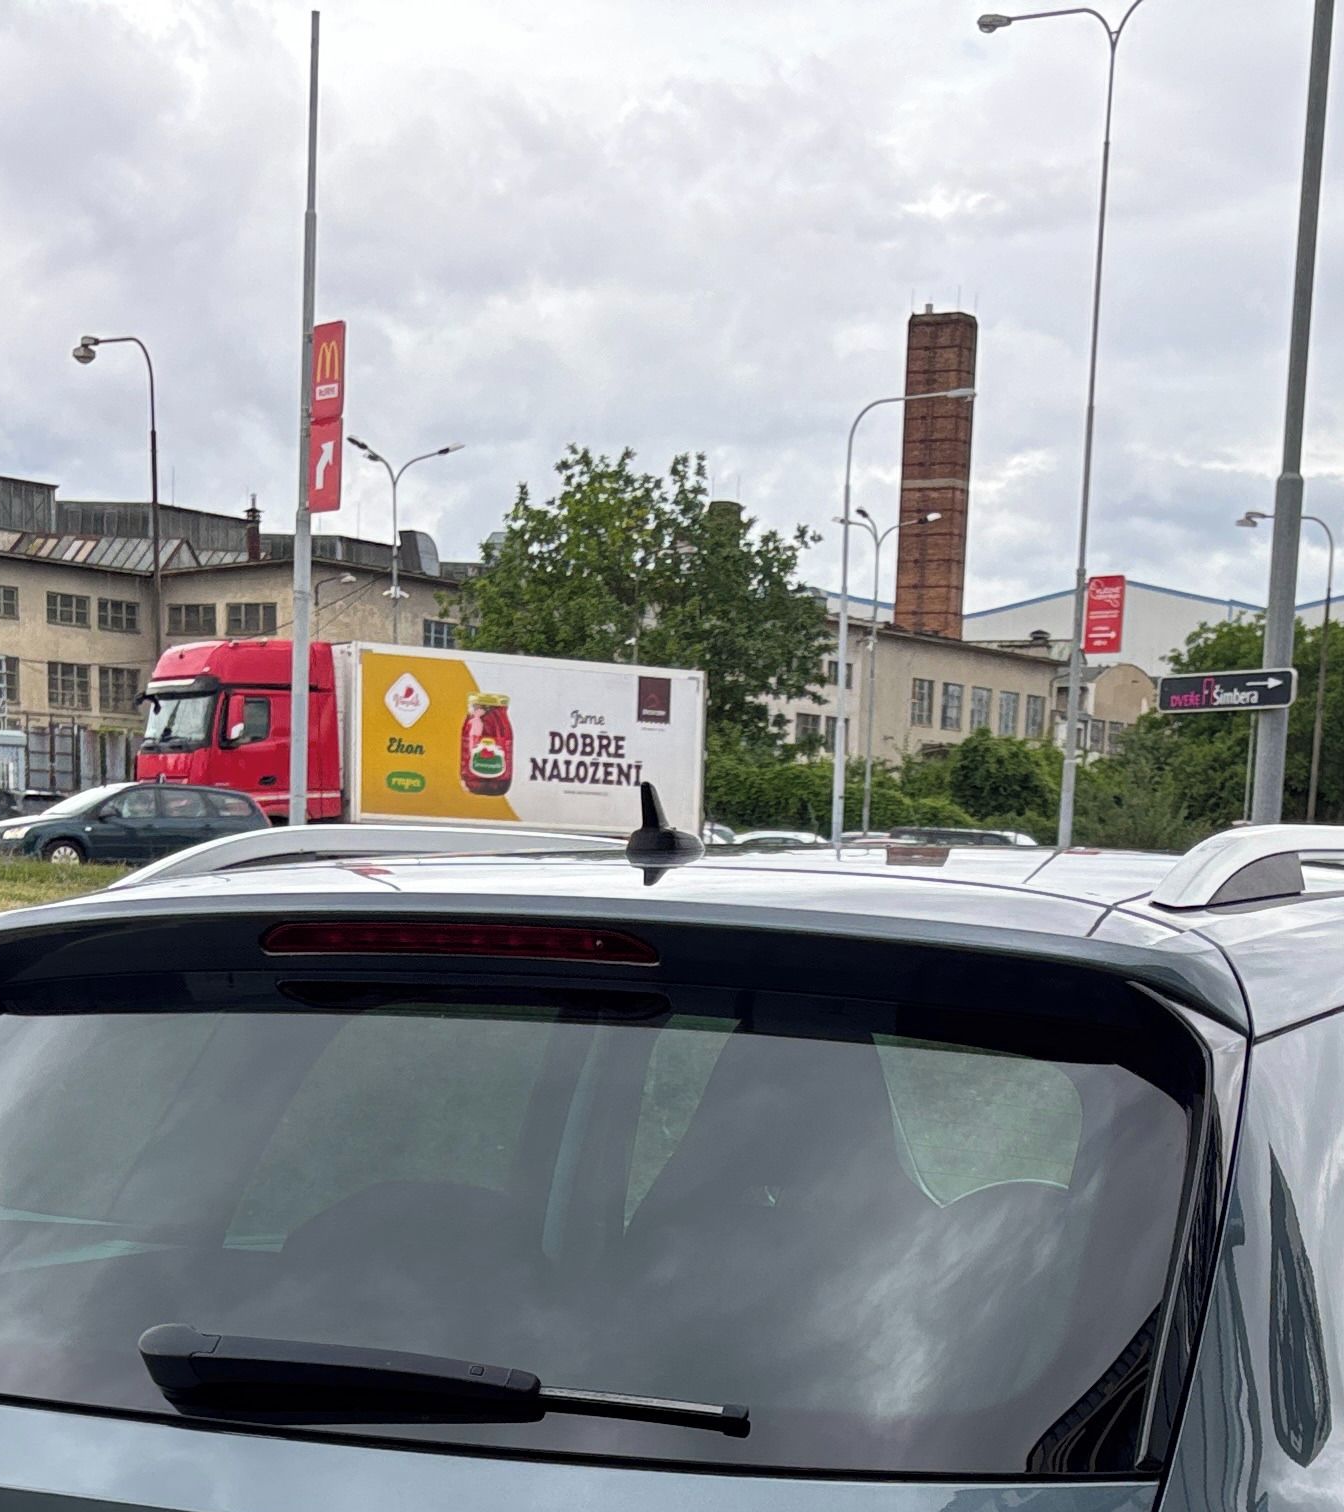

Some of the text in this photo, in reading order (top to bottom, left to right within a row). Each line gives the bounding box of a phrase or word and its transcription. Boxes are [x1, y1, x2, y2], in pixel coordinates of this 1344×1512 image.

[1213, 684, 1259, 705] Šimbera
[570, 709, 605, 728] Jsme
[549, 730, 626, 759] DOBŘE
[530, 757, 643, 787] NALOŽENÍ
